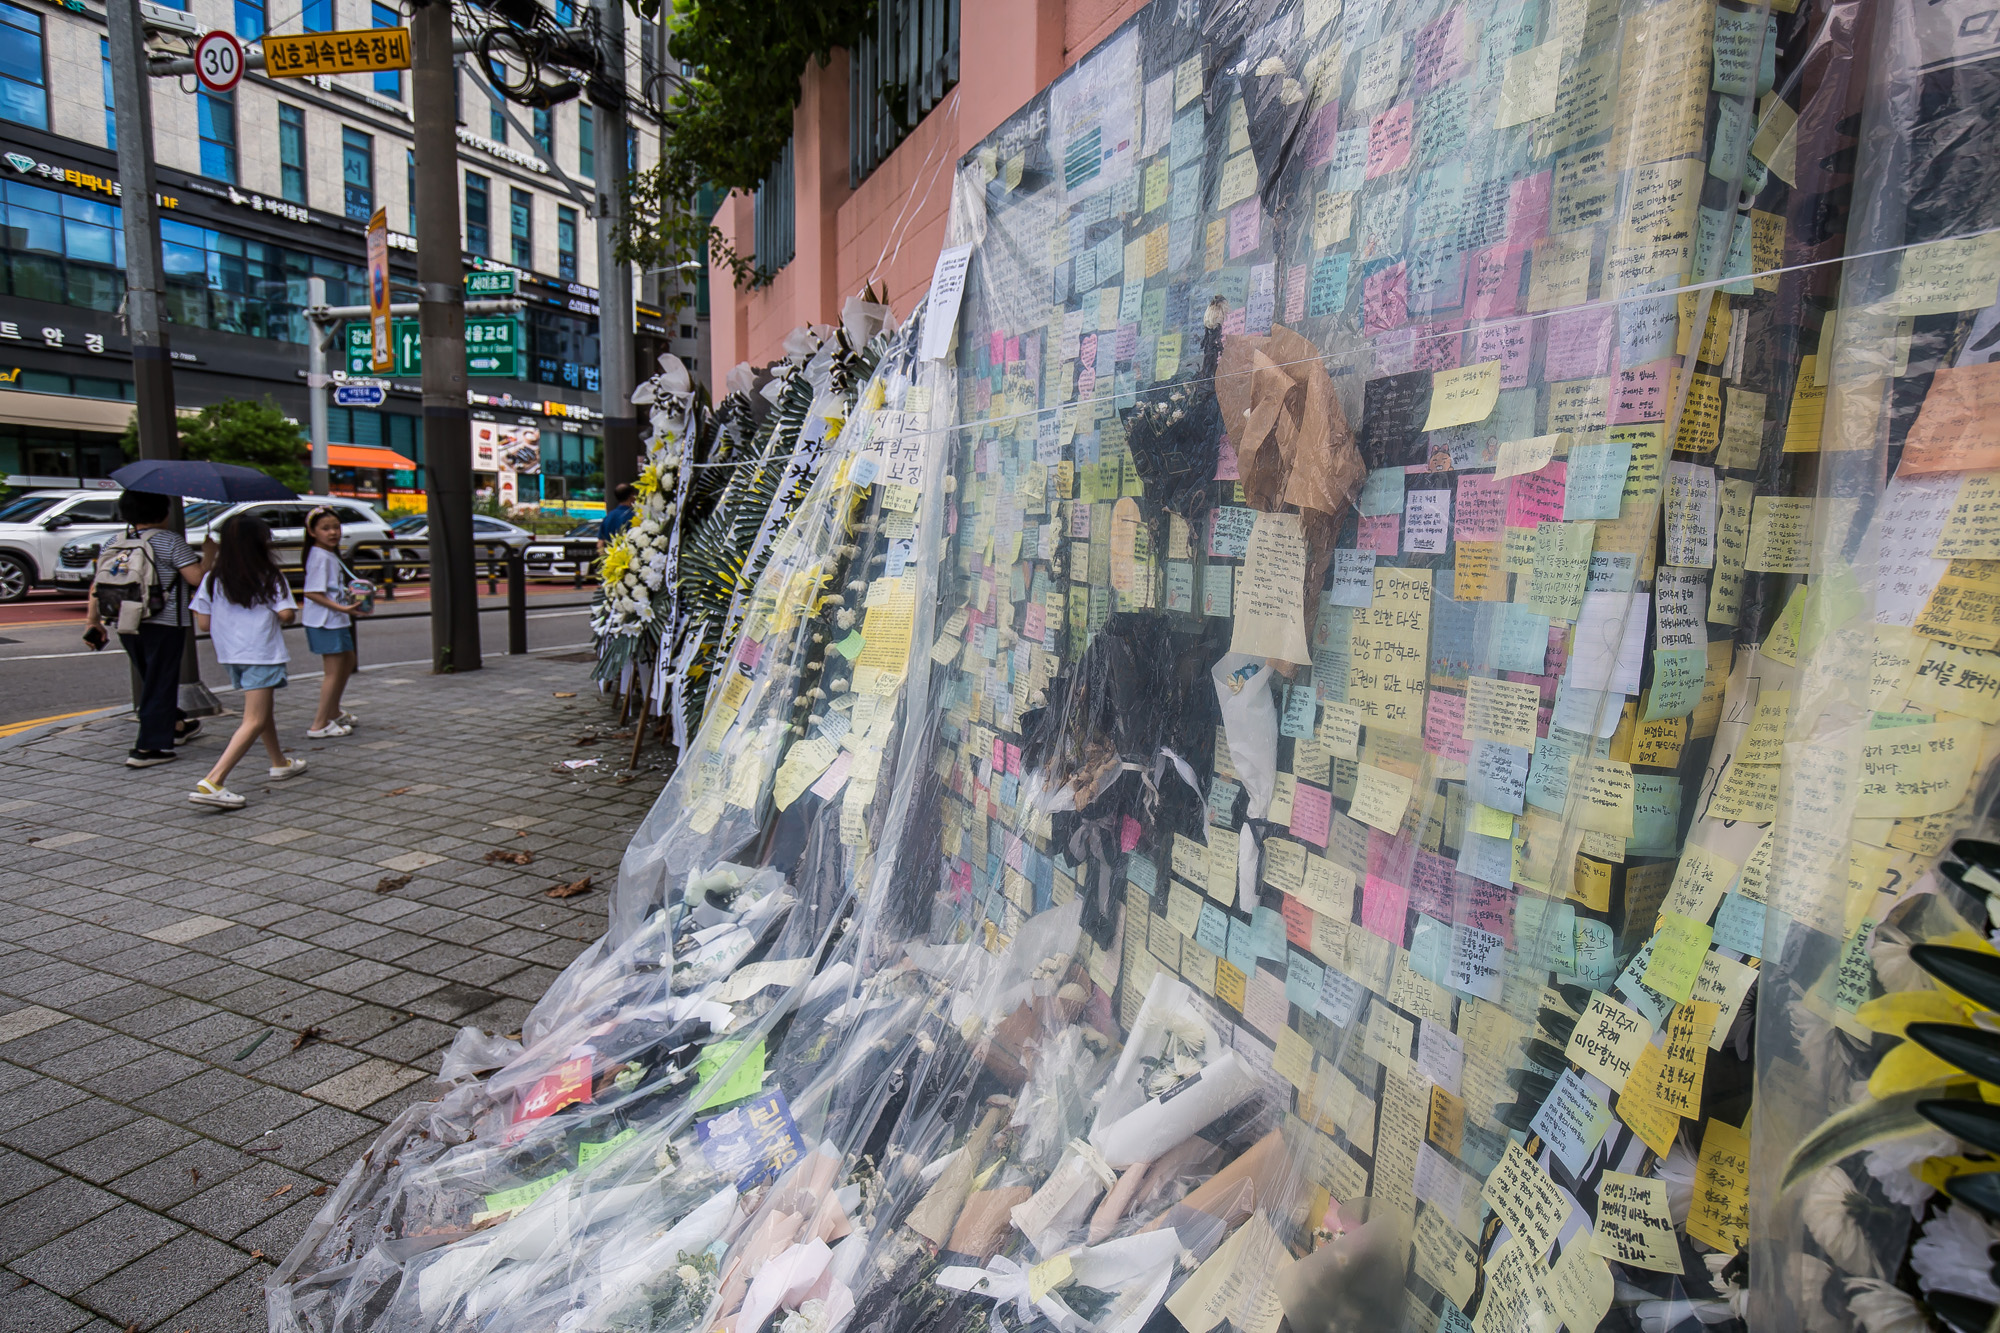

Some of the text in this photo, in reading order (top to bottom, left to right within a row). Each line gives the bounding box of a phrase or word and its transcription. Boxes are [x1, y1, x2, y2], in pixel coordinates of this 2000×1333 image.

[204, 46, 234, 75] 30
[270, 34, 407, 71] 신호과속단속장비
[874, 412, 922, 434] 서비스
[887, 462, 923, 485] 보장
[1389, 578, 1409, 600] 악성
[1411, 580, 1430, 601] 민원
[1353, 608, 1370, 624] 으로
[1397, 610, 1424, 631] 타살.
[1351, 636, 1421, 663] 진상 규명하라.
[1350, 667, 1378, 688] 교권이
[1383, 674, 1402, 692] 없는
[1916, 659, 1956, 687] 교사를
[1385, 703, 1407, 720] 없다.
[1862, 737, 1955, 758] 삼가 고인의 명복을
[1865, 762, 1902, 775] 빕니다.
[1863, 779, 1952, 795] 교권 찾겠습니다.
[1396, 972, 1433, 1003] 학부모도
[1591, 999, 1639, 1033] 지켜주지
[1597, 1020, 1621, 1045] 못해
[1574, 1033, 1630, 1080] 미안합니다.
[1709, 1150, 1746, 1174] 선생님
[1705, 1168, 1735, 1190] 죽음이
[1603, 1182, 1627, 1202] 선생님,
